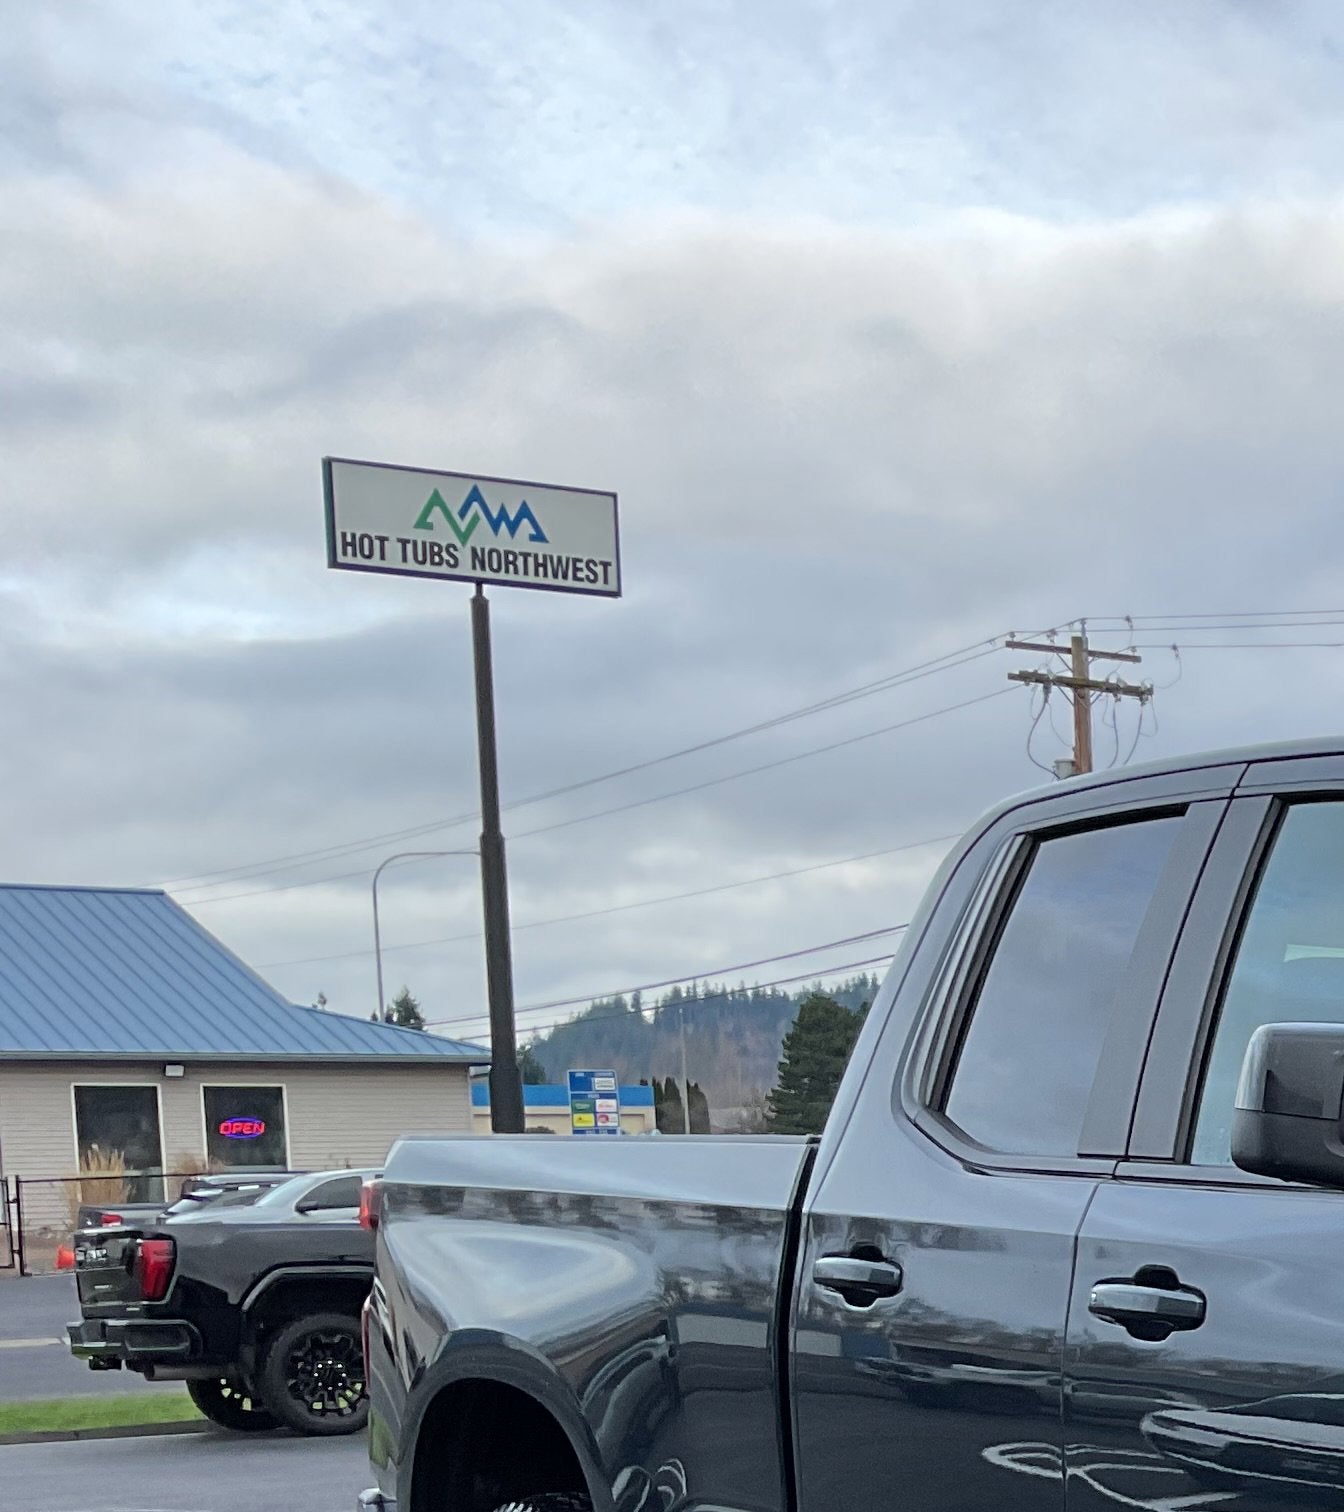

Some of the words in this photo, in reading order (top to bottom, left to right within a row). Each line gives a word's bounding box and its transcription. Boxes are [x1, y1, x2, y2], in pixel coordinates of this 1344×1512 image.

[340, 531, 389, 561] HOT
[396, 537, 460, 569] TUBS
[470, 546, 613, 585] NORTHWEST
[219, 1121, 265, 1135] OPEN
